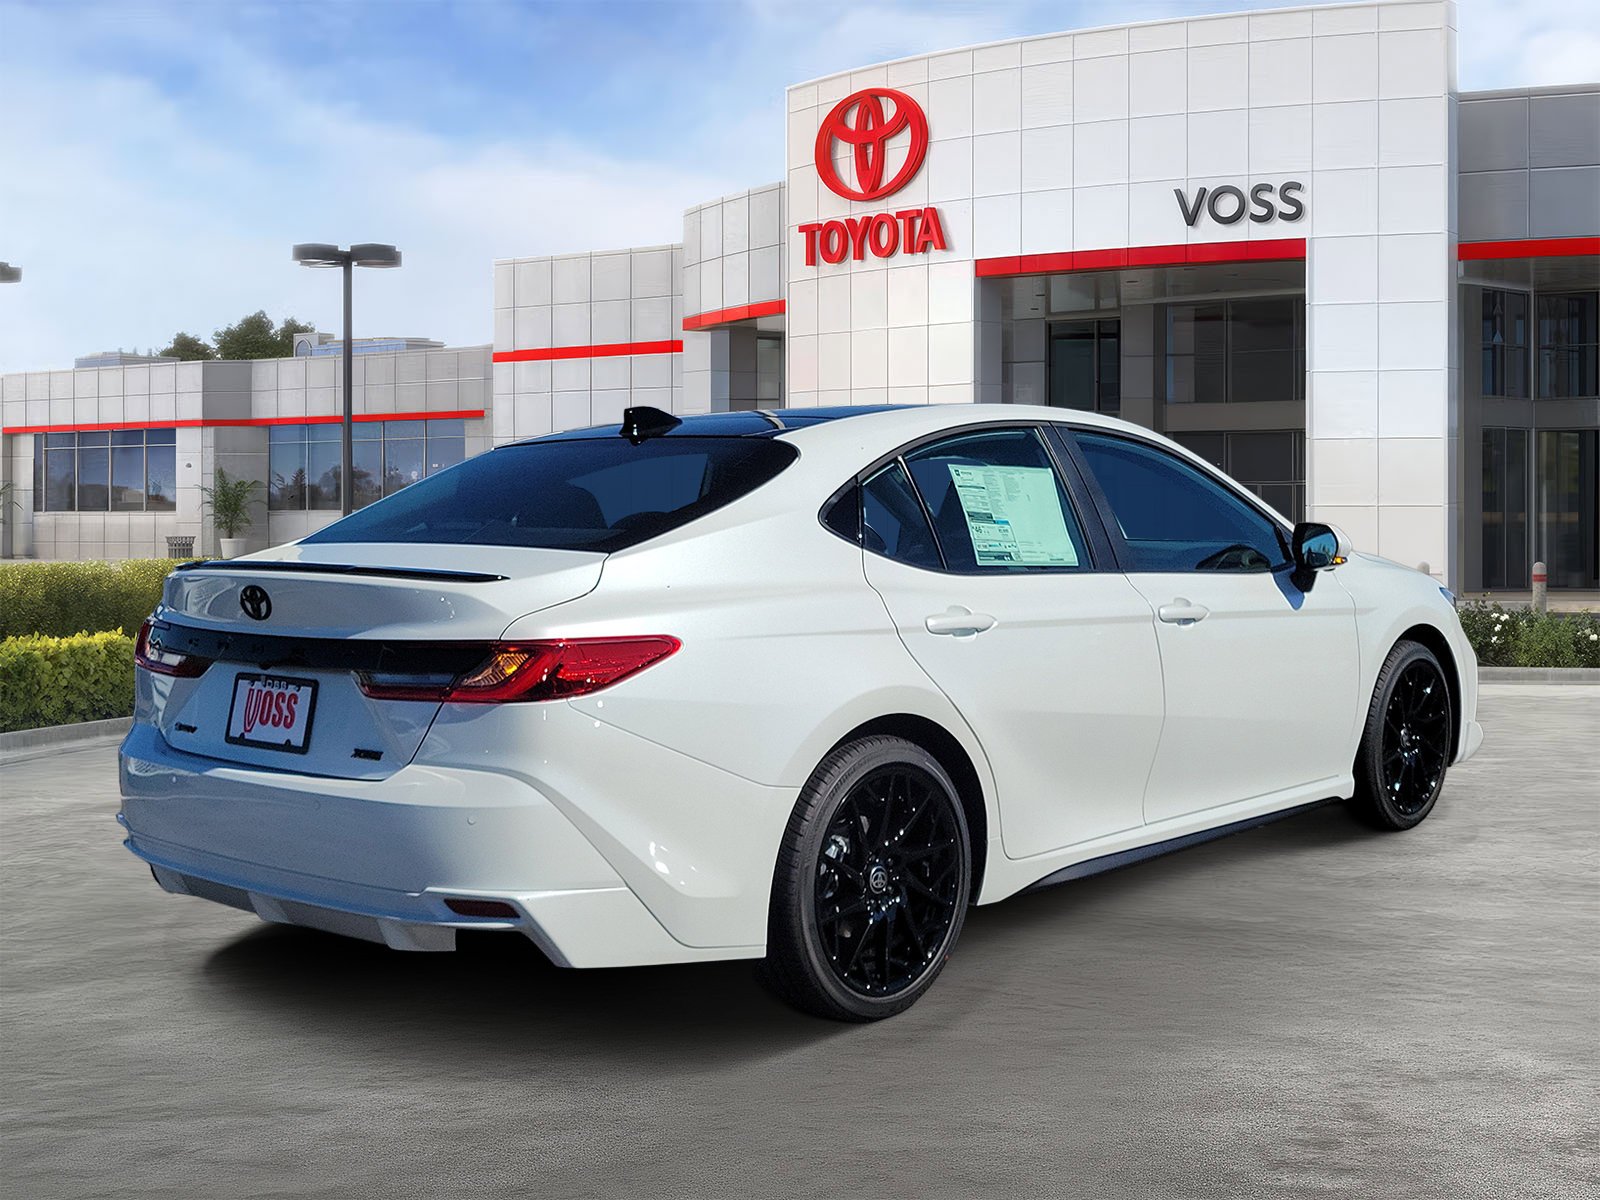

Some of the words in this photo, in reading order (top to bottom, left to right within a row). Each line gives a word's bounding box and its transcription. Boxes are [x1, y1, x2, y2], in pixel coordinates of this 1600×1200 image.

[1174, 181, 1303, 226] VOSS
[798, 207, 947, 266] TOYOTA
[244, 688, 298, 732] VOSS
